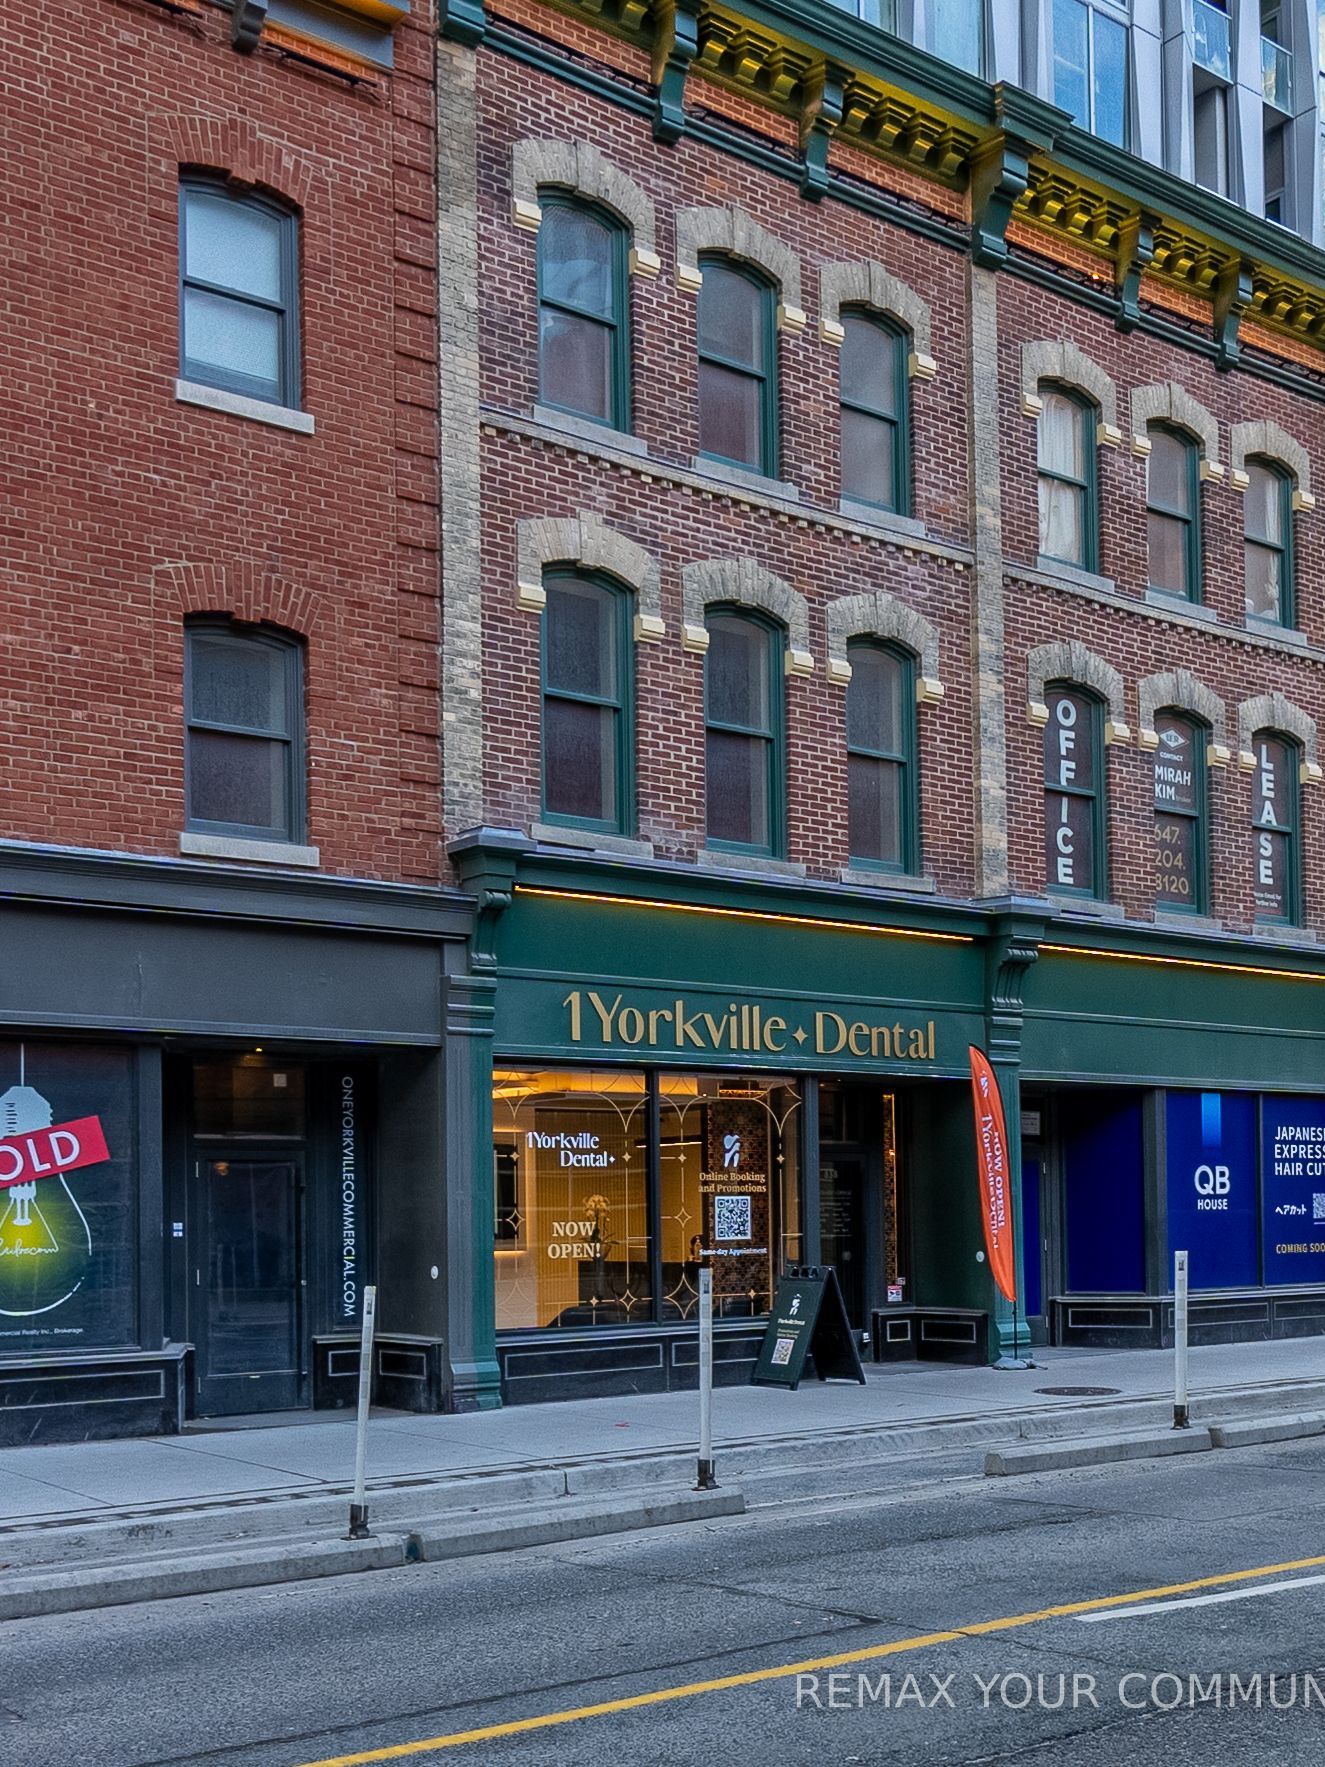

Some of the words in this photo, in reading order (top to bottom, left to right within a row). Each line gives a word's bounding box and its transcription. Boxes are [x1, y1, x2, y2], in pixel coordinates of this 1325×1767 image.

[1154, 764, 1191, 786] MIRAH
[1056, 699, 1077, 885] OFFICE
[1154, 782, 1176, 801] KIM
[1259, 744, 1278, 885] LEASE
[1155, 849, 1186, 870] 204.
[562, 990, 787, 1053] 1Yorkville
[815, 1011, 936, 1060] Dental
[526, 1131, 600, 1149] 1Yorkville
[0, 1131, 80, 1181] OLD
[560, 1150, 608, 1167] Dental
[699, 1172, 728, 1181] Online
[730, 1172, 766, 1183] Booking
[1274, 1162, 1303, 1176] HAIR
[698, 1184, 715, 1192] and
[717, 1183, 767, 1192] Promotions
[1194, 1164, 1231, 1195] QB
[341, 1076, 356, 1317] ONEYORKVILLECOMMERCIAL.COM
[1197, 1199, 1228, 1210] HOUSE
[1275, 1204, 1307, 1215] ヘアカット
[552, 1221, 597, 1237] NOW
[547, 1242, 601, 1259] OPEN!
[729, 1247, 767, 1256] Appointment
[1276, 1243, 1308, 1254] COMING
